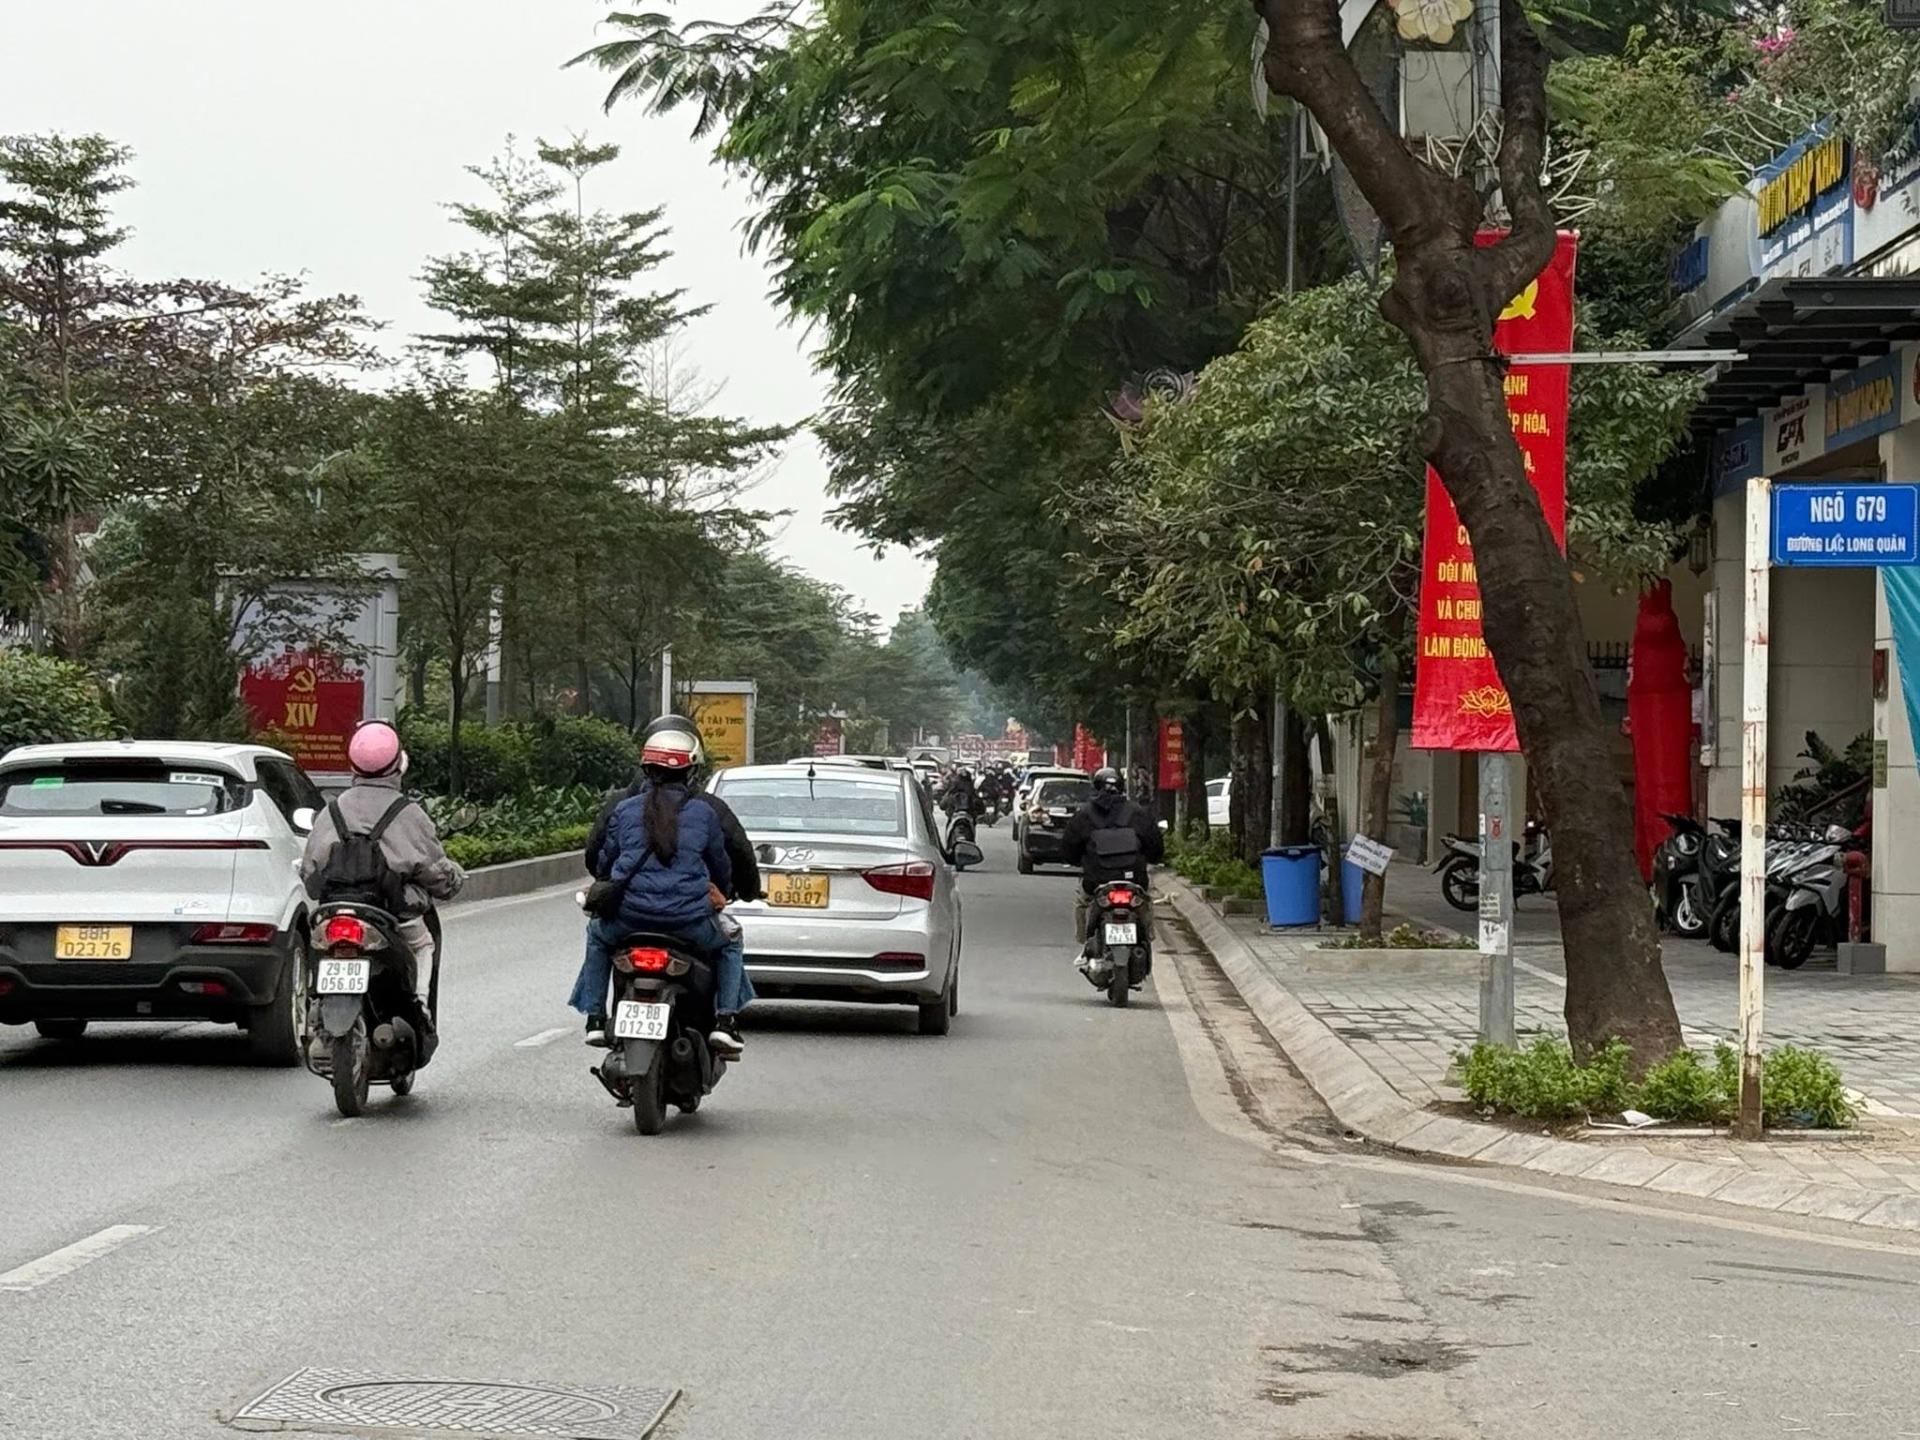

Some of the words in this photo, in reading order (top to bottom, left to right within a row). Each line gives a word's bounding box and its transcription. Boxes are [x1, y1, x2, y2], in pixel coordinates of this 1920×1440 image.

[1523, 409, 1550, 437] HÓA,
[1810, 491, 1845, 522] NGÕ
[1856, 496, 1886, 522] 679
[1847, 537, 1874, 552] LONG
[1437, 595, 1453, 620] VÀ
[1453, 632, 1487, 662] ĐỘNG
[284, 703, 318, 727] XIV
[64, 942, 122, 957] 023.76
[321, 977, 364, 991] 056.05
[619, 1020, 663, 1037] 012.92
